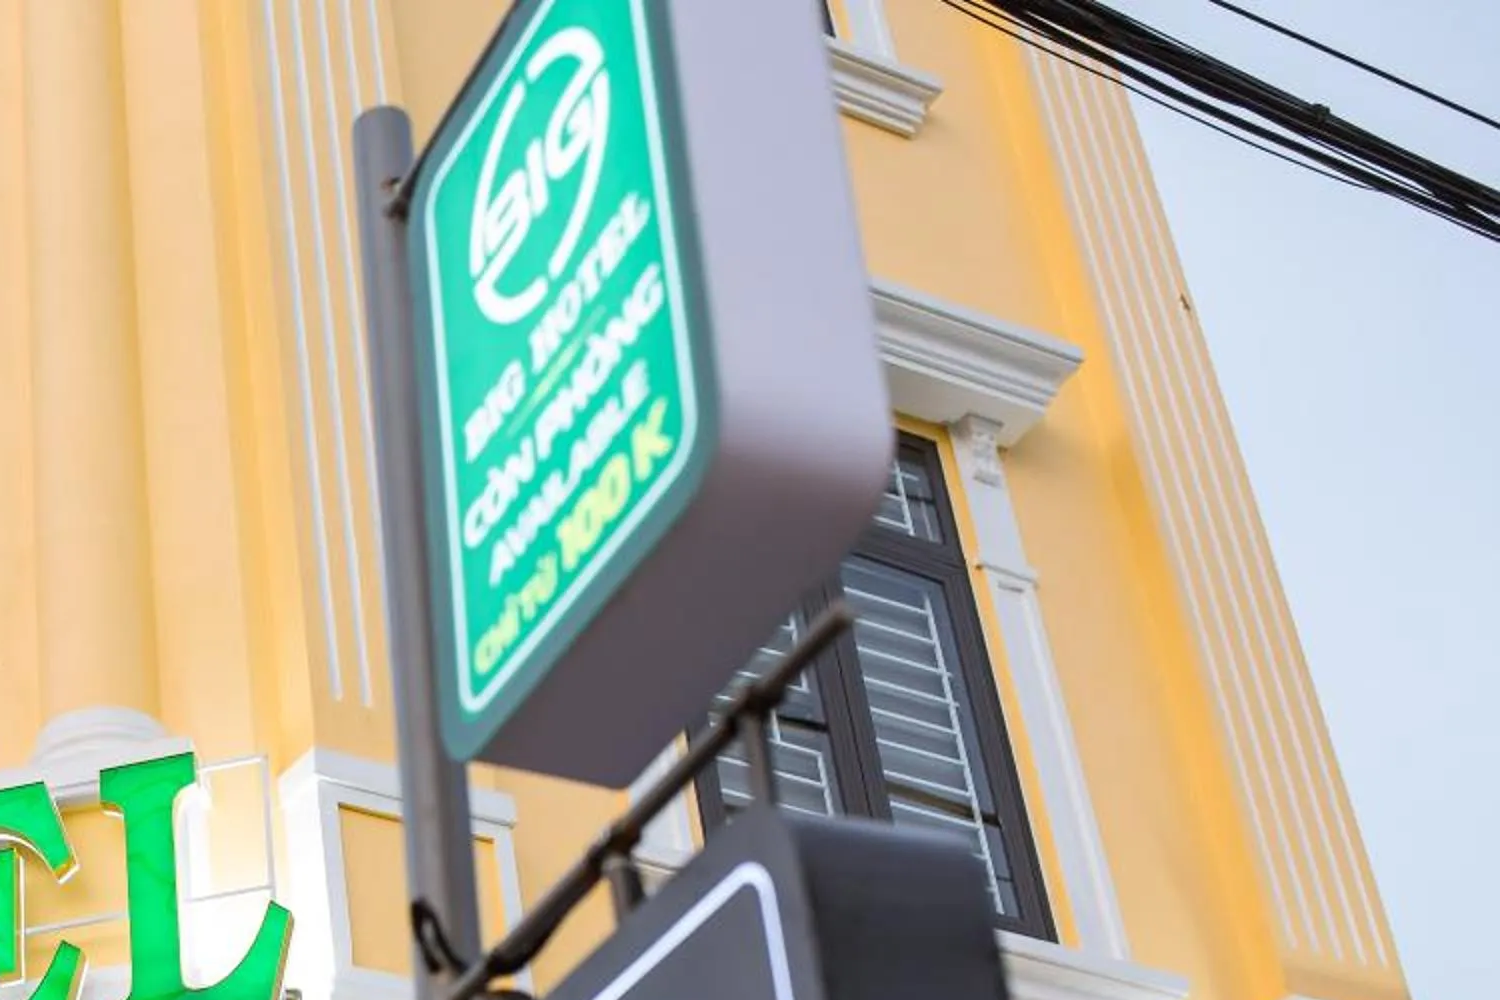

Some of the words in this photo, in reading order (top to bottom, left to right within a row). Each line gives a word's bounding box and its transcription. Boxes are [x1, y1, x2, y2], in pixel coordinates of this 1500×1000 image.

[460, 361, 526, 464] BIG
[529, 191, 651, 377] HOTEL
[488, 359, 650, 588] AVAILABLE
